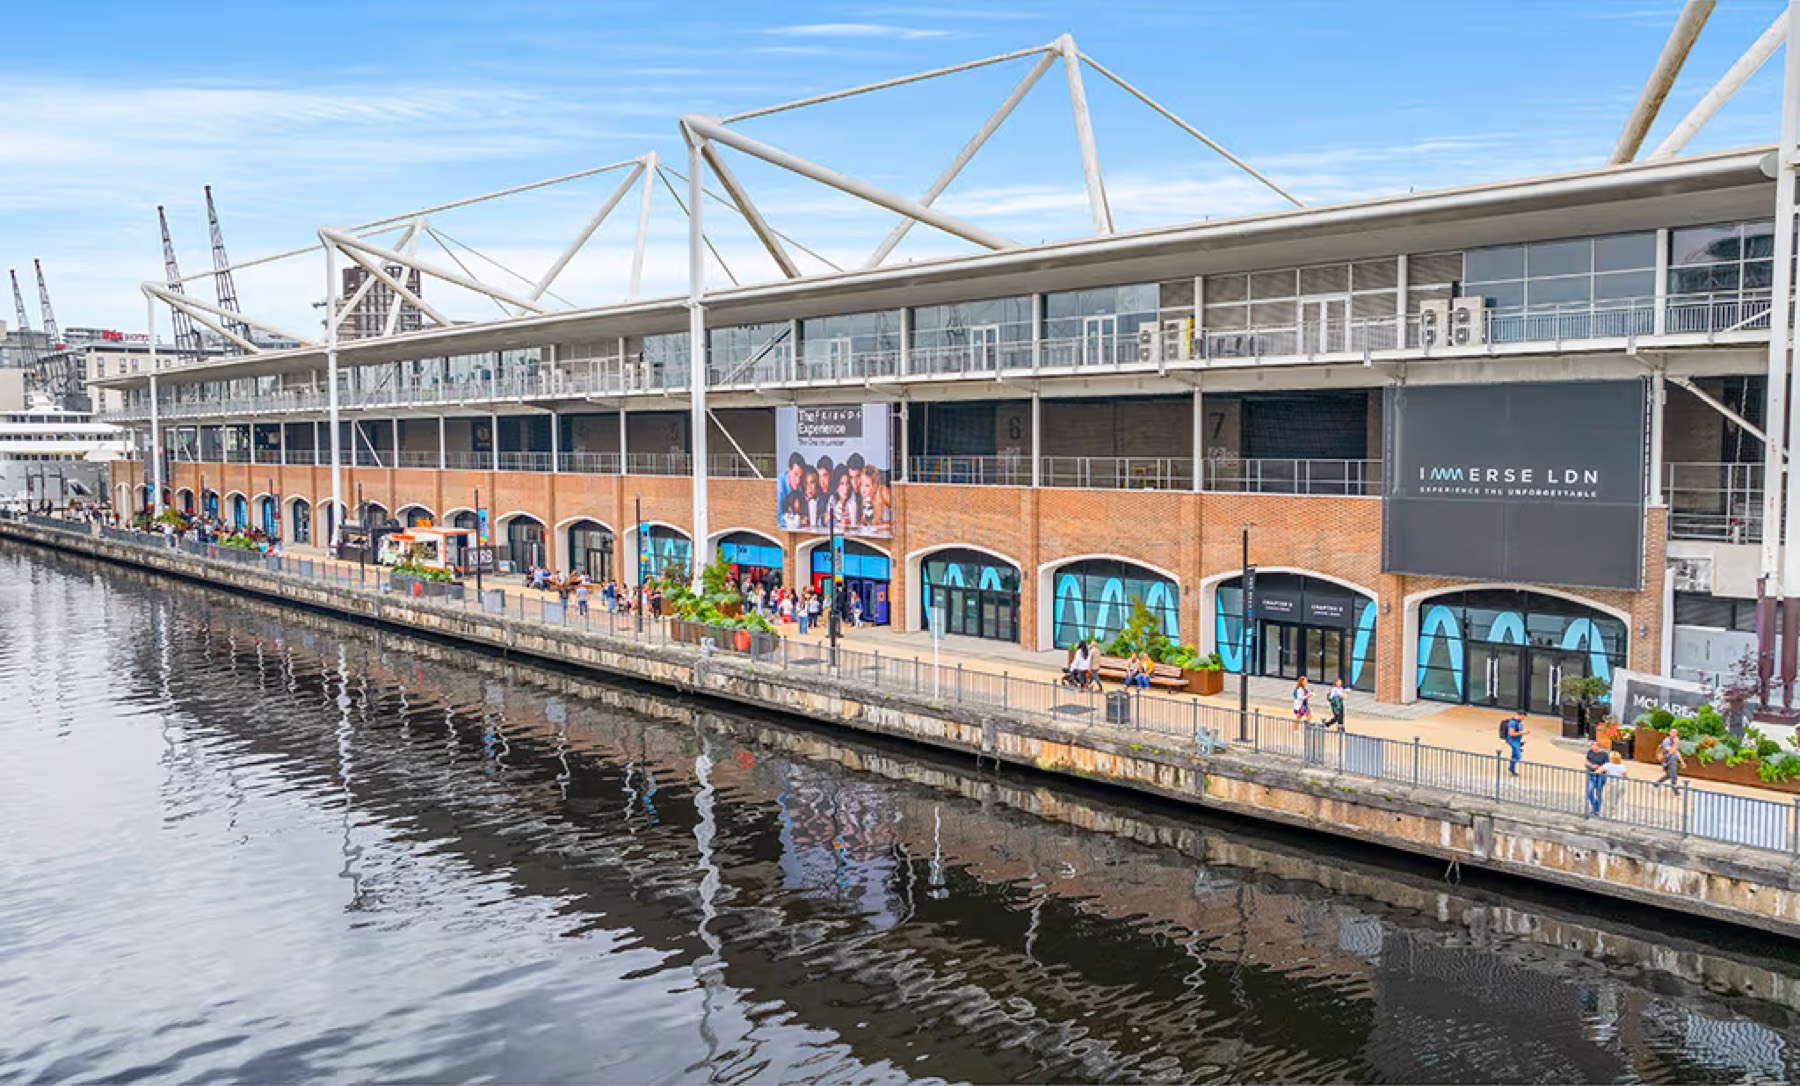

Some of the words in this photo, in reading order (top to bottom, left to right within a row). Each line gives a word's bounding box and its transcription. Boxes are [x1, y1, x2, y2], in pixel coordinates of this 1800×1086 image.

[799, 410, 815, 422] The
[799, 423, 846, 436] Experience
[1009, 416, 1021, 440] 6
[1209, 412, 1225, 439] 7
[1548, 469, 1598, 485] LDN
[1419, 486, 1480, 495] EXPERIENCE
[1484, 488, 1503, 496] THE
[1507, 489, 1598, 498] UNFORGETTABLE
